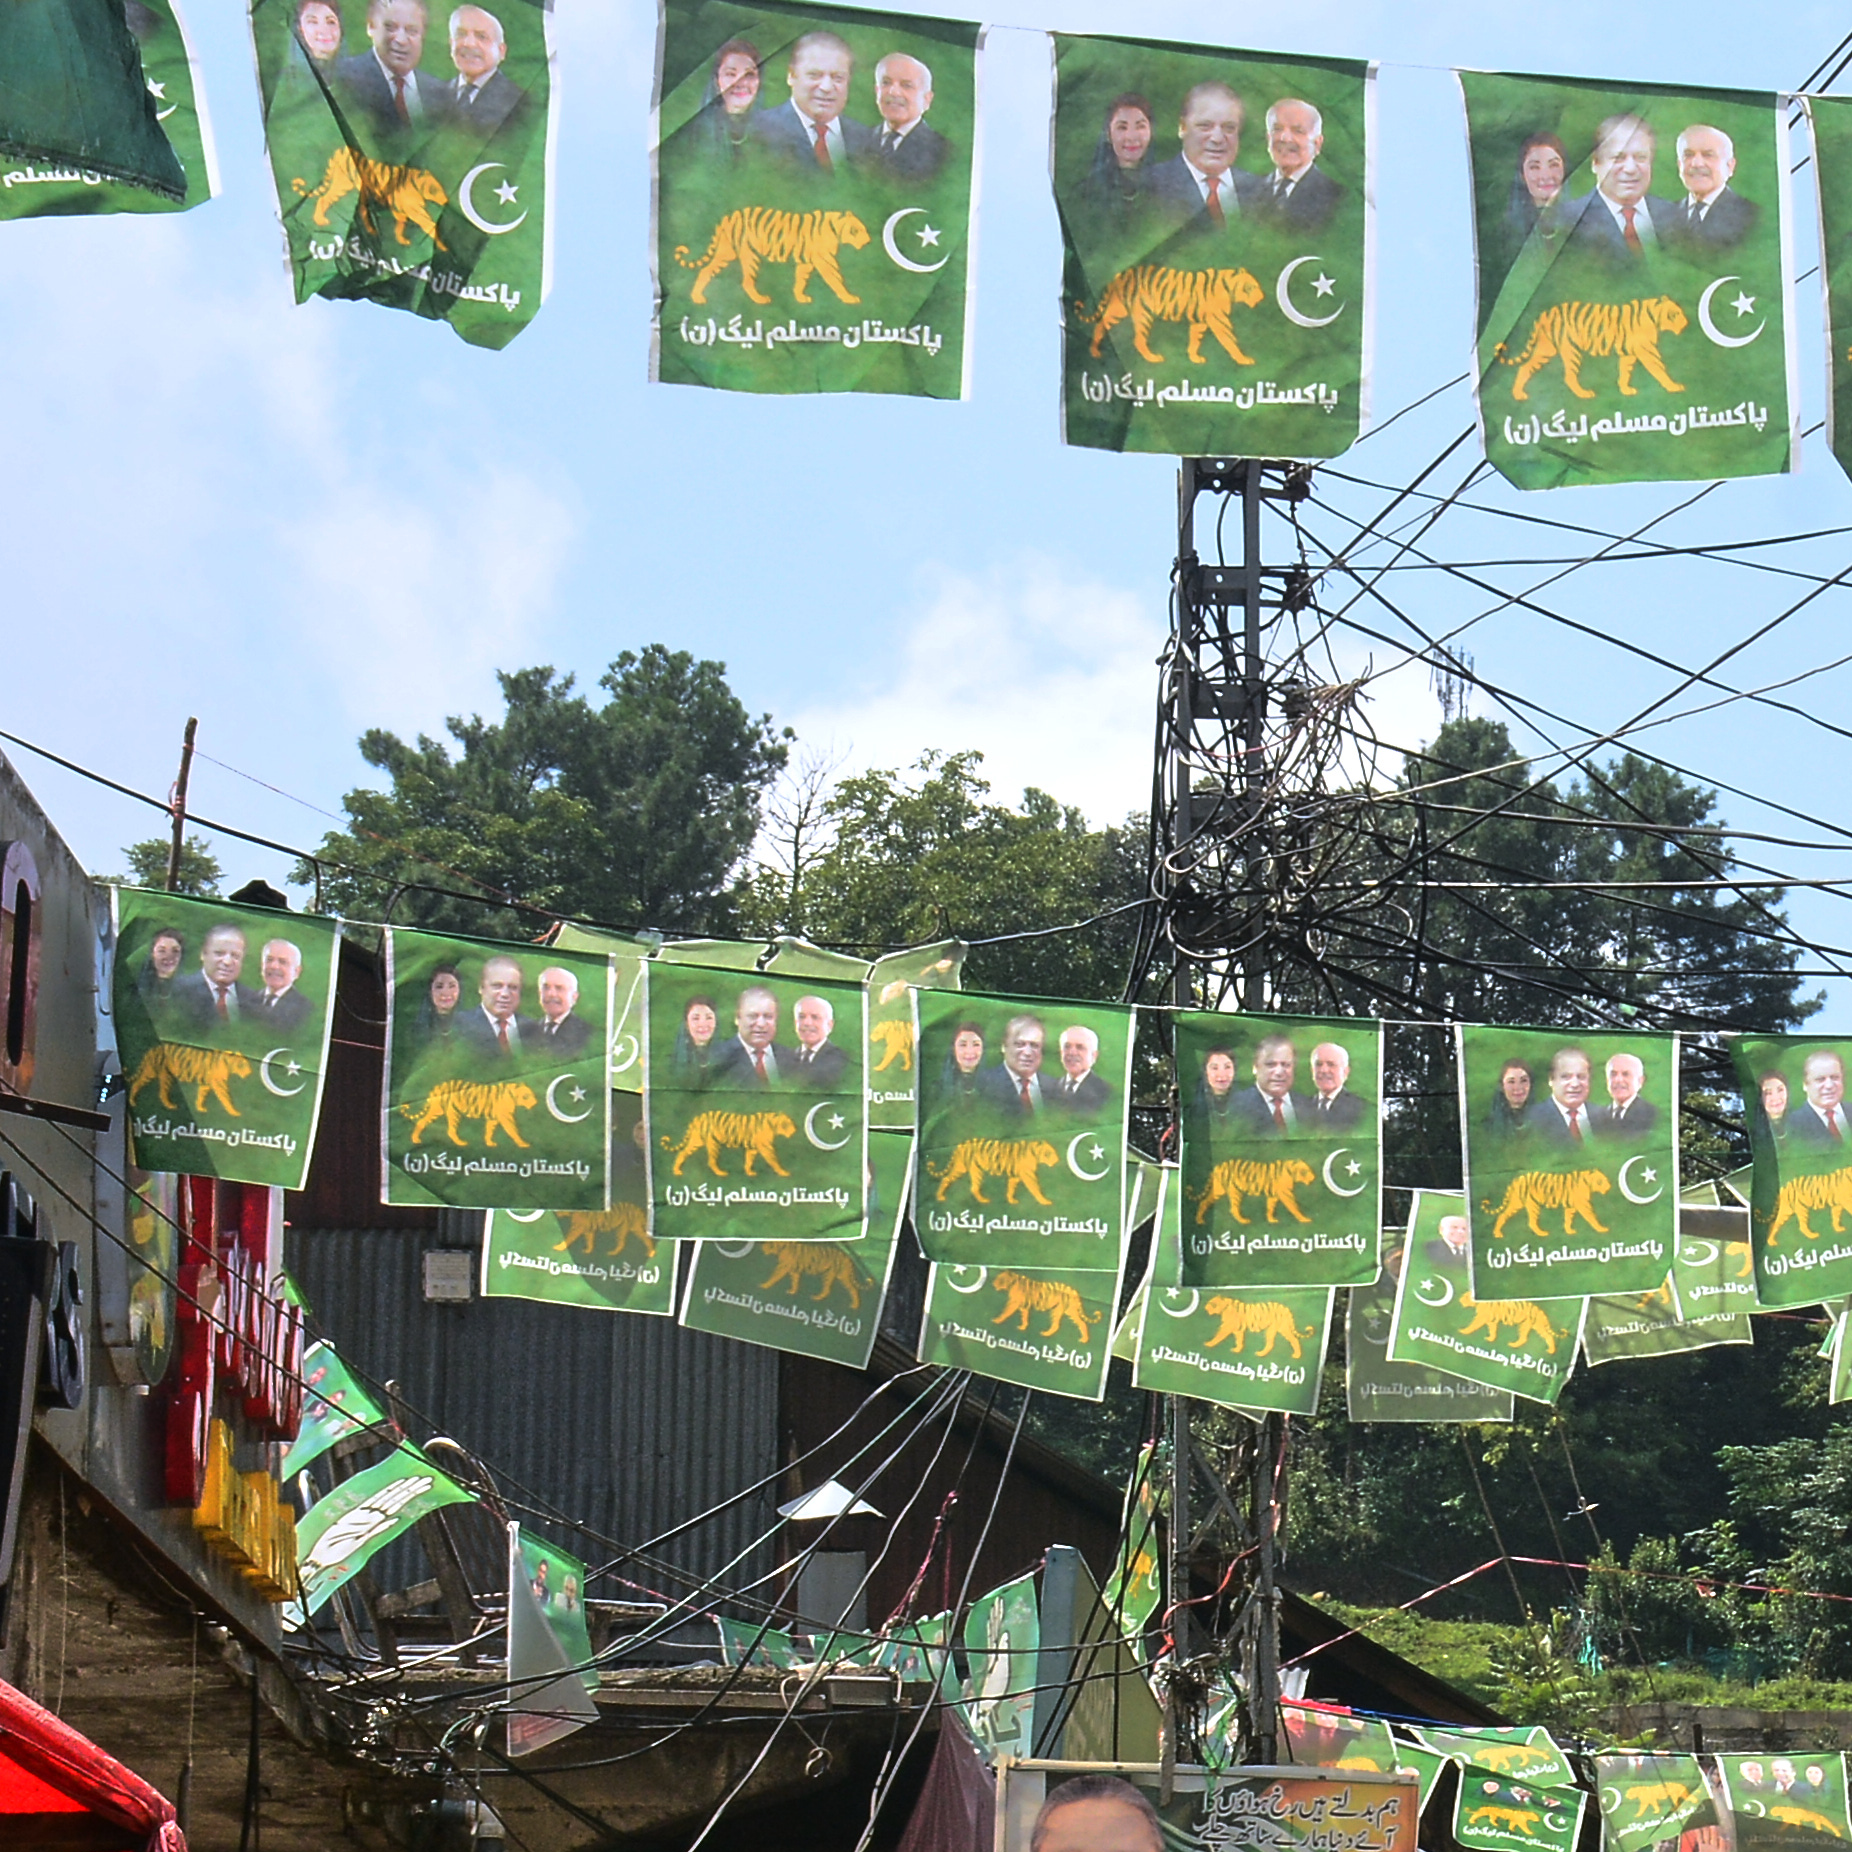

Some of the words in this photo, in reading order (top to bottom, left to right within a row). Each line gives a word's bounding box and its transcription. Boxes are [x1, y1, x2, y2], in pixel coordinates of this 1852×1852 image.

[717, 313, 763, 349] لیگ
[765, 319, 841, 350] مسلم
[842, 319, 942, 357] پاکستان
[1113, 372, 1155, 408] لیگ
[1156, 379, 1234, 408] مسلم
[1235, 381, 1338, 414] پاکستان
[1541, 408, 1588, 444] لیگ
[1590, 411, 1668, 442] مسلم
[1668, 401, 1768, 436] پاکستان
[430, 1151, 462, 1175] لیگ
[463, 1157, 518, 1177] مسلم
[519, 1158, 590, 1181] پاکستان
[953, 1209, 984, 1233] لیگ
[985, 1214, 1039, 1235] مسلم
[1039, 1216, 1108, 1240] پاکستان
[1512, 1243, 1545, 1267] لیگ
[1545, 1245, 1601, 1267] مسلم
[1599, 1239, 1664, 1263] پاکستان
[1376, 1797, 1400, 1829] ہم
